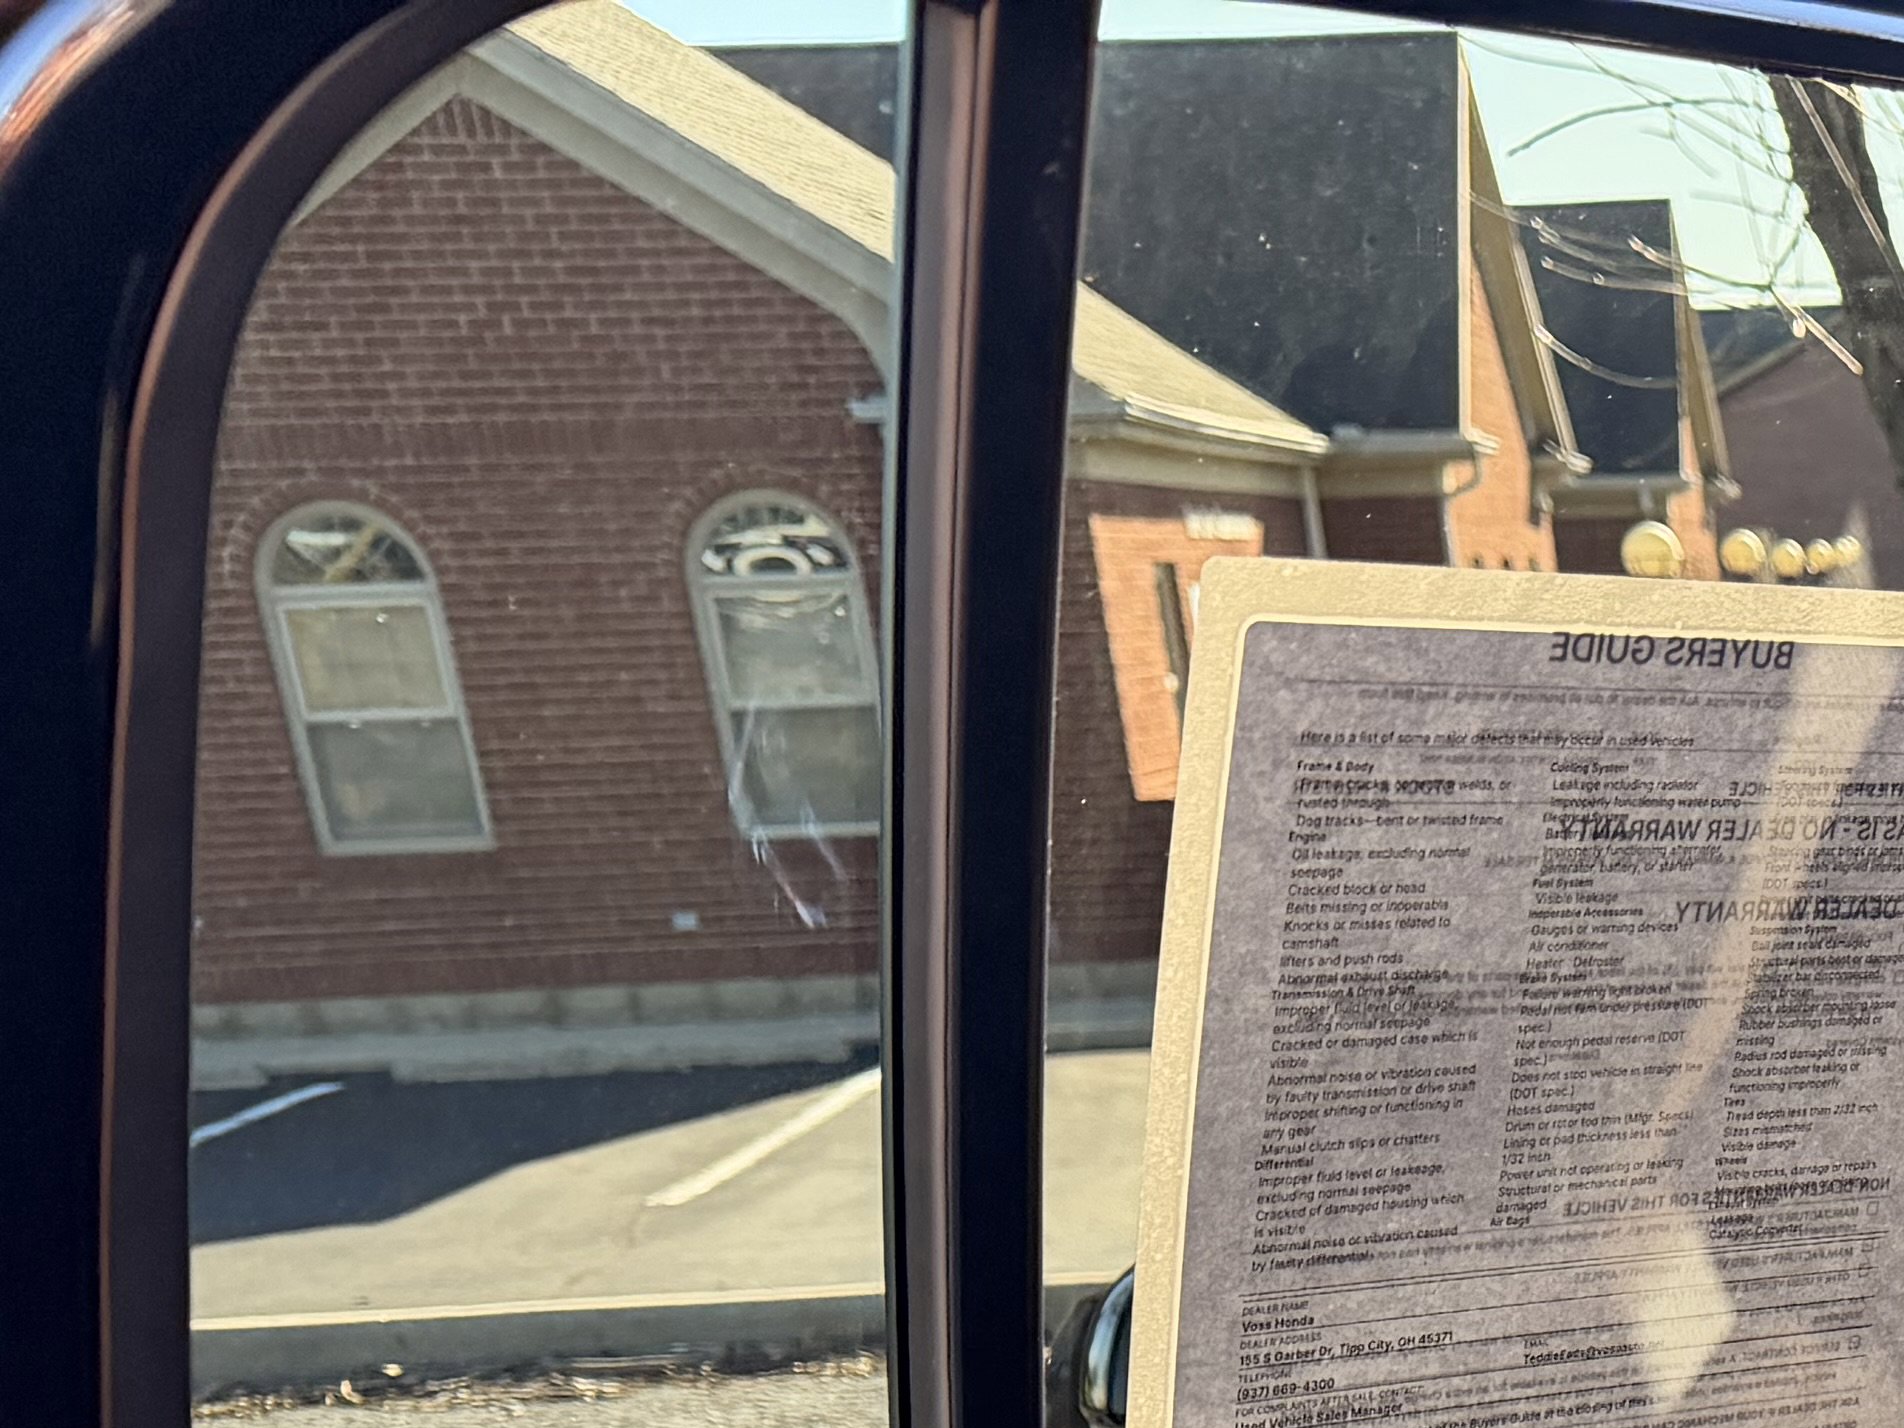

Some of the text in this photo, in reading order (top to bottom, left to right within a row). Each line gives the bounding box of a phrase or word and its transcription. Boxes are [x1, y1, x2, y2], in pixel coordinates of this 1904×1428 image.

[1242, 1314, 1314, 1332] Voss Honda
[1240, 1331, 1453, 1365] 155 S Garber Dr, Tipp City, OH 45371
[1237, 1377, 1335, 1400] (937) 669-4300
[1268, 1413, 1313, 1428] Vehicle
[1316, 1408, 1348, 1423] Sales
[1350, 1401, 1403, 1420] Manager
